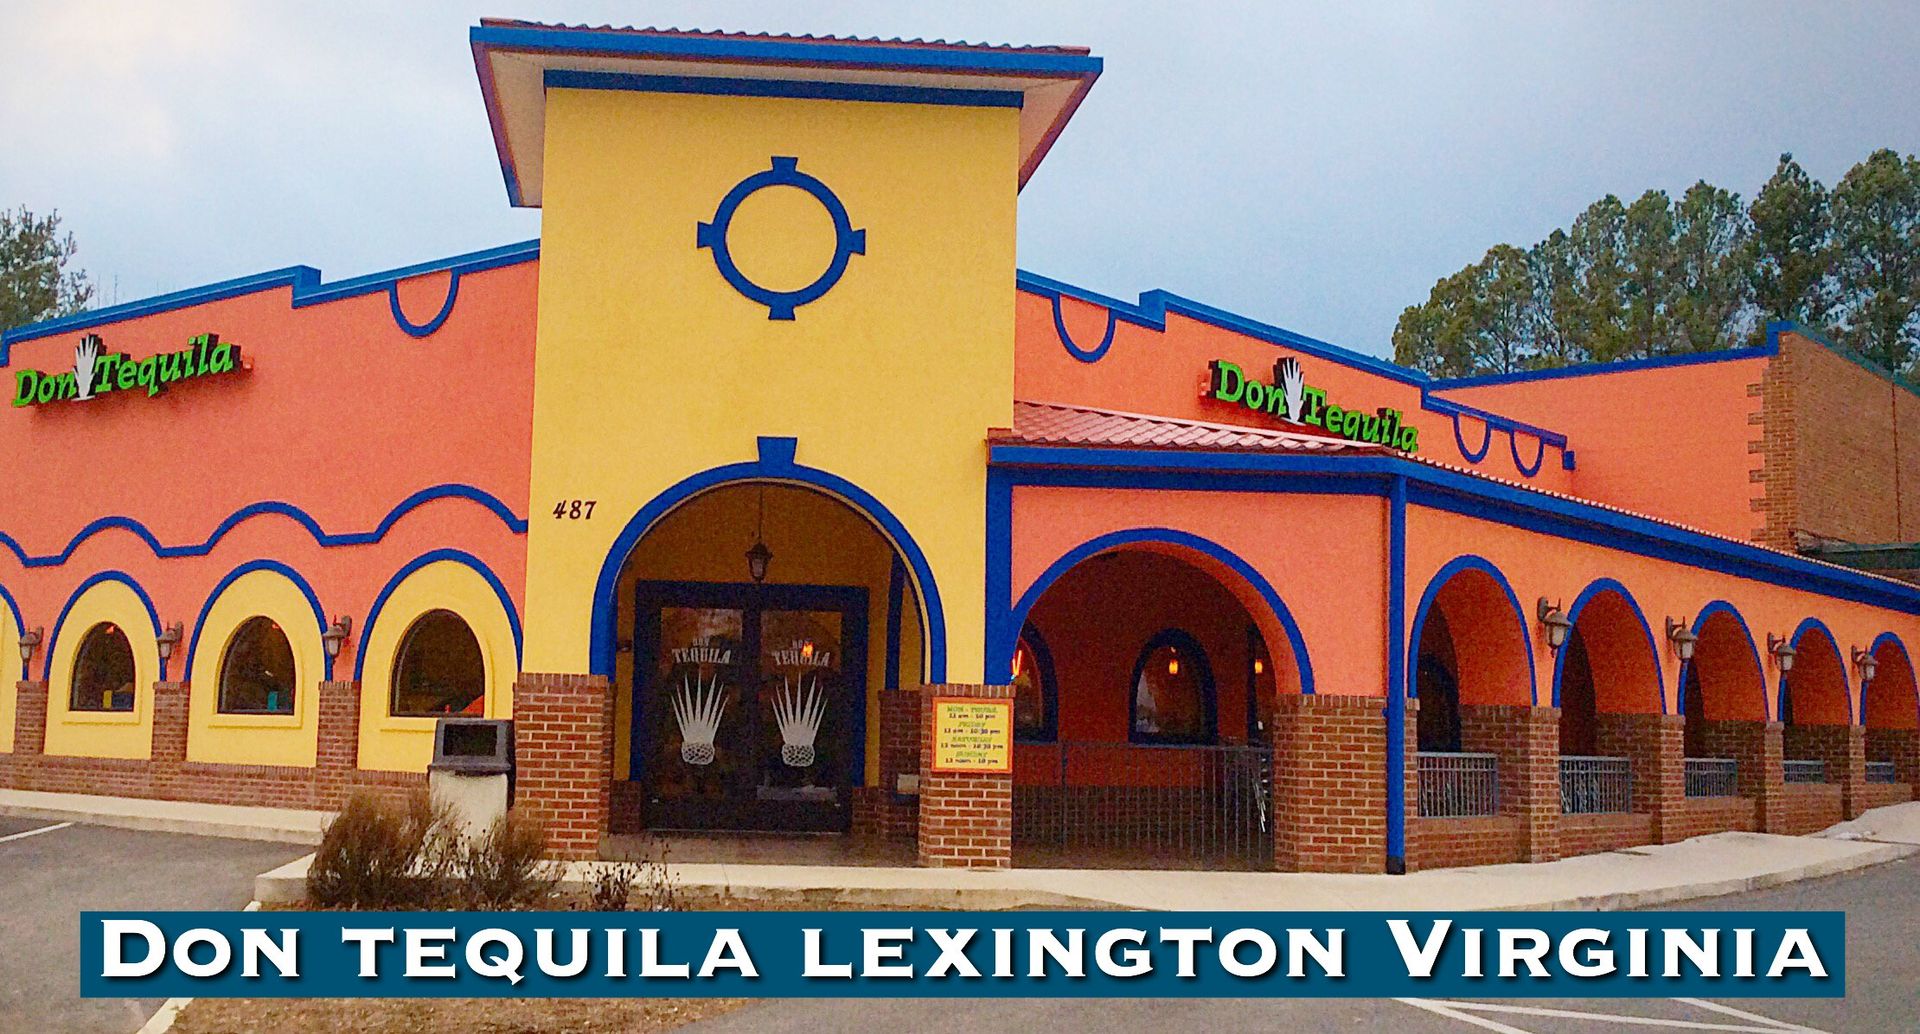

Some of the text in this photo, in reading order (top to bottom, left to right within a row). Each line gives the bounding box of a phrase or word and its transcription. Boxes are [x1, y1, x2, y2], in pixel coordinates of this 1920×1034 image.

[12, 333, 234, 408] Don Tequila
[1217, 360, 1418, 452] Don Tequila
[552, 499, 597, 520] 487
[671, 647, 732, 664] TEQUILA
